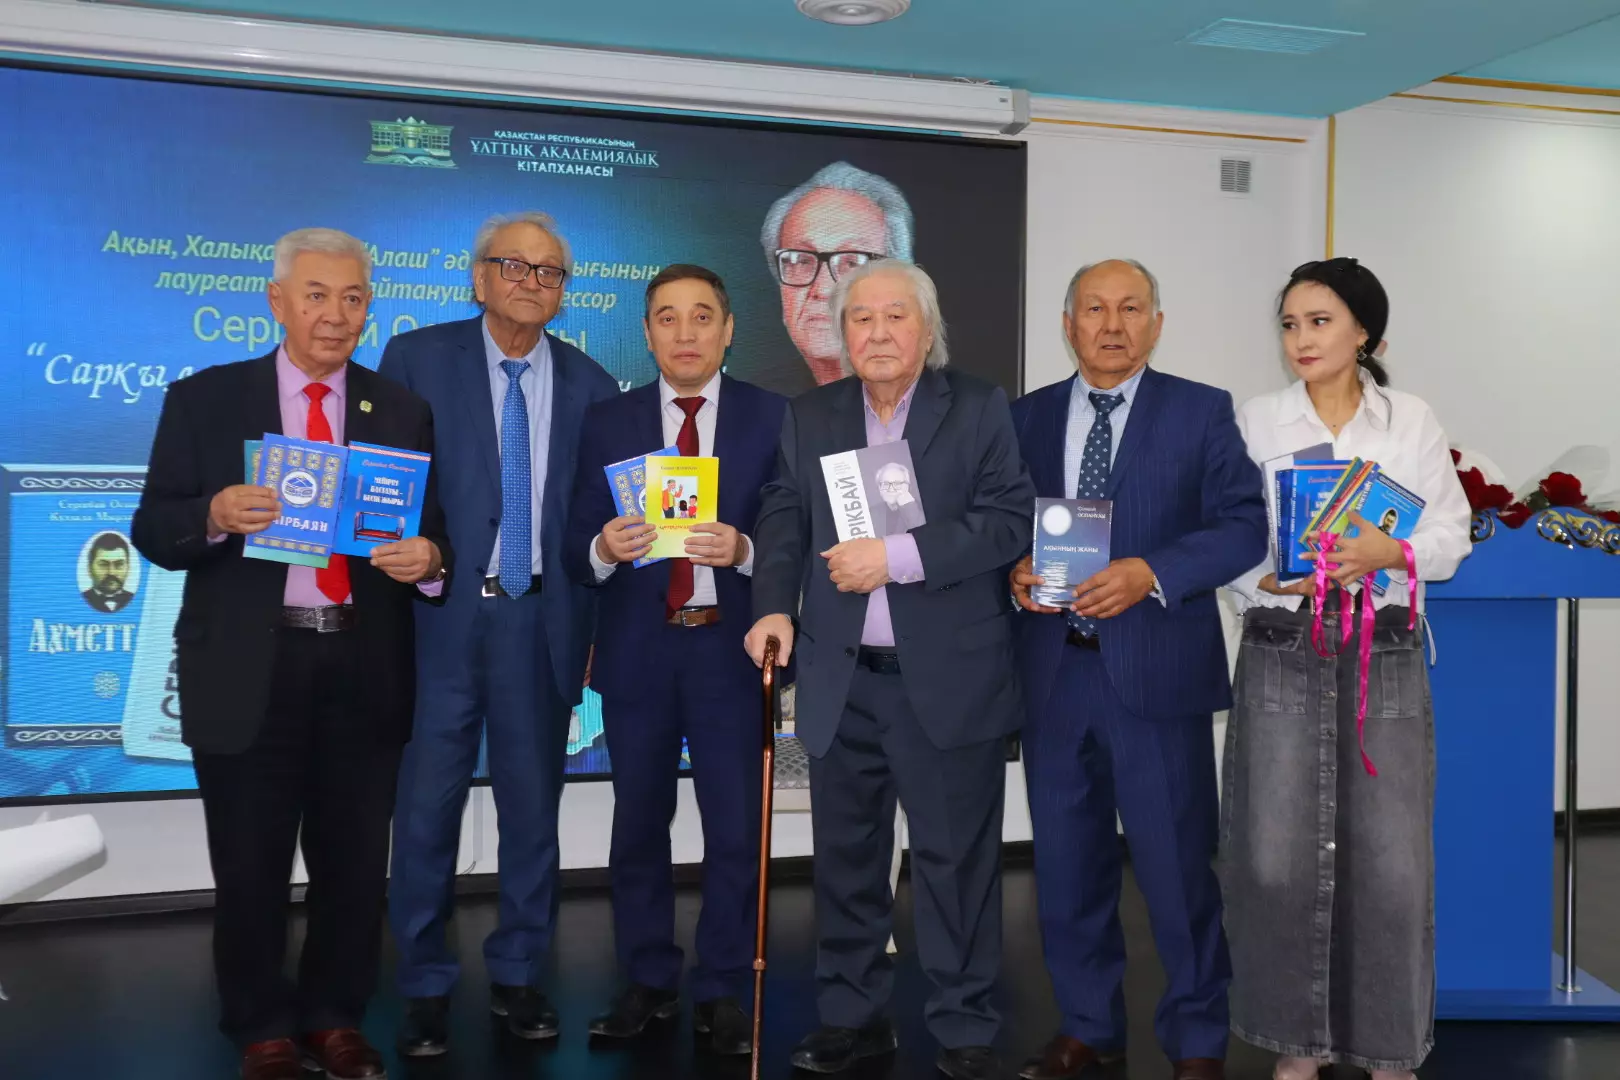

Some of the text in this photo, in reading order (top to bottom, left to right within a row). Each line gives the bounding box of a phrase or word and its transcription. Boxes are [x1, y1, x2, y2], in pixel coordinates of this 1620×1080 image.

[470, 139, 659, 168] ҰЛТТЫҚ АКАДЕМИЯЛЫҚ
[494, 130, 635, 149] ҚАЗАҚСТАН РЕСПУБЛИКАСЫНЫҢ
[517, 161, 614, 177] КІТАПХАНАСЫ
[101, 230, 178, 260] Ақын,
[183, 234, 275, 263] Халықа
[154, 270, 273, 296] лауреат
[562, 291, 617, 314] ессор
[834, 475, 869, 540] РІКБАЙ
